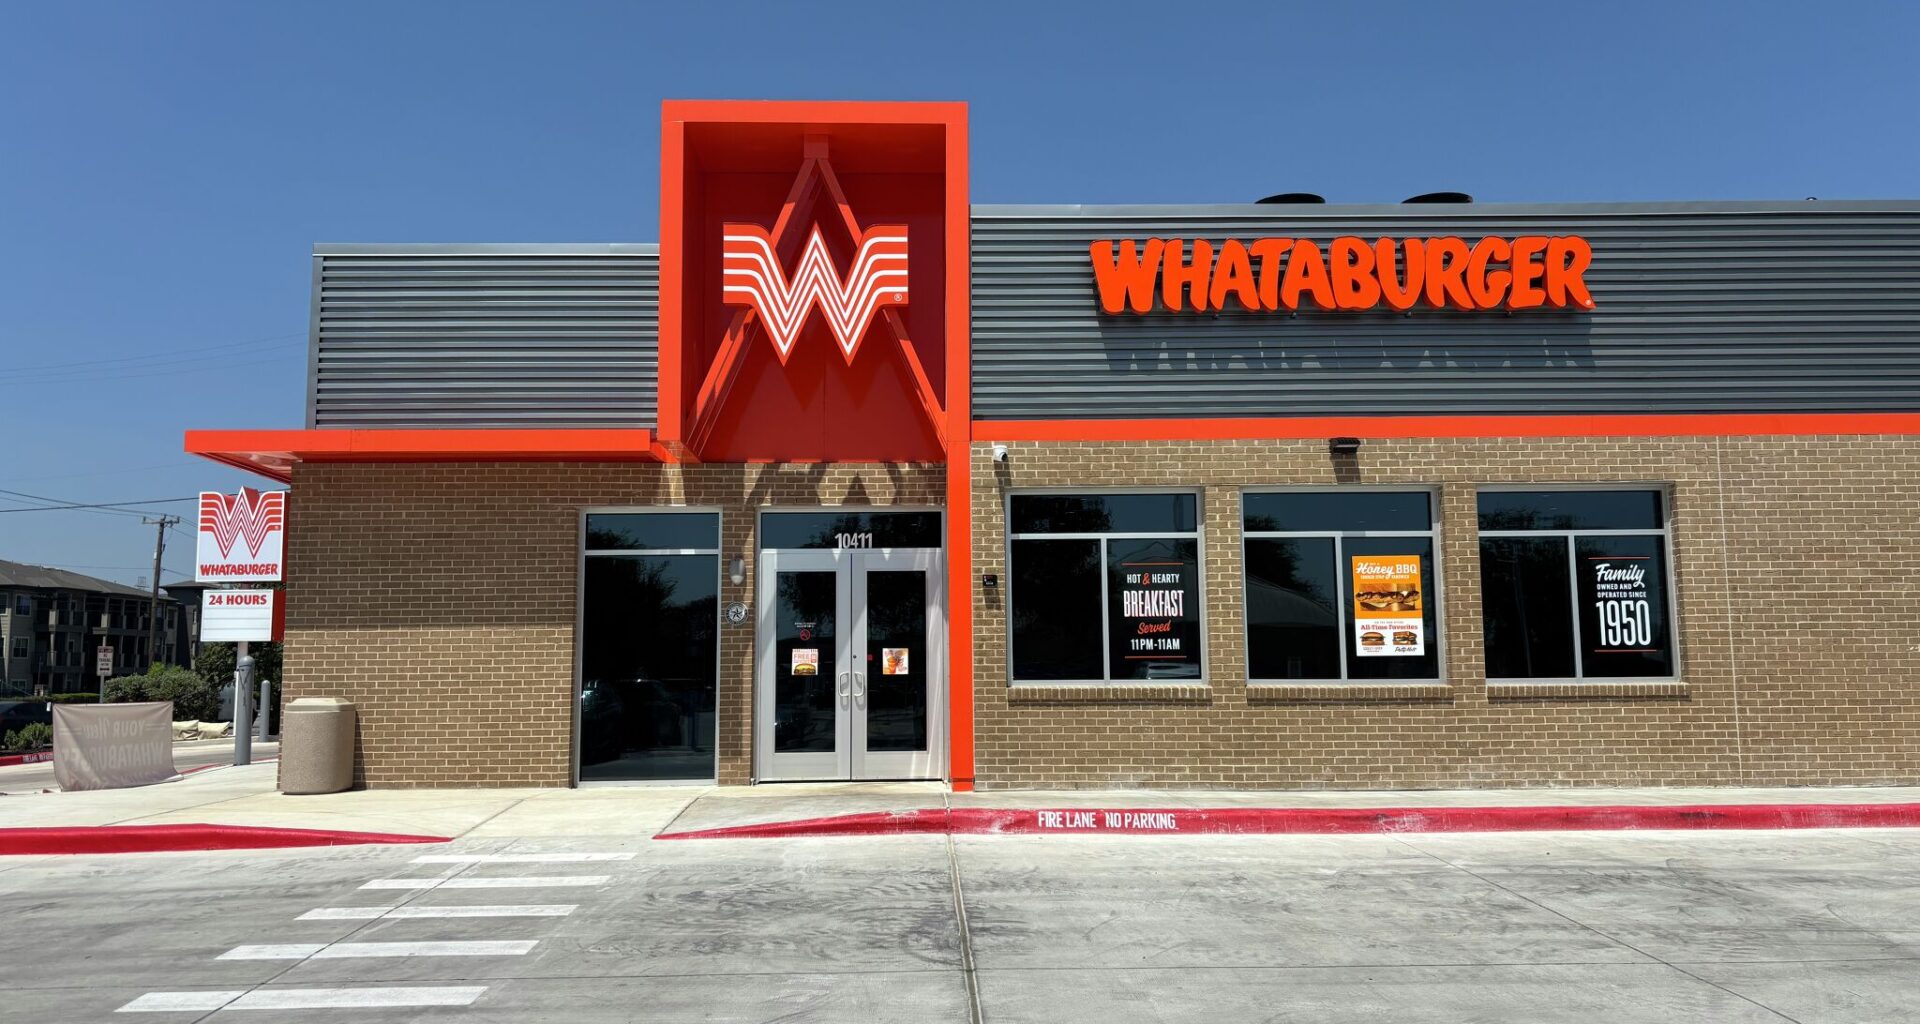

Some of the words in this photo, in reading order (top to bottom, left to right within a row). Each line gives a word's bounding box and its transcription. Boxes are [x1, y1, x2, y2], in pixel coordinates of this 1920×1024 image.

[1089, 236, 1596, 314] WHATABURGER
[834, 532, 872, 548] 10411
[200, 563, 279, 577] WHATABURGER
[1356, 562, 1395, 579] Honey
[1396, 564, 1417, 574] BBQ
[1596, 563, 1645, 588] Family
[1126, 574, 1142, 584] HOT
[1142, 572, 1150, 585] &
[1152, 574, 1180, 584] HEARTY
[208, 594, 224, 606] 24
[226, 594, 268, 606] HOURS
[1124, 590, 1184, 617] BREAKFAST
[1138, 620, 1172, 634] Served
[1596, 600, 1651, 646] 1950
[1131, 638, 1180, 650] 11PM-11AM
[1037, 811, 1063, 828] FIRE
[1066, 811, 1097, 828] LANE
[1105, 812, 1122, 828] NO
[1124, 812, 1176, 829] PARKING
